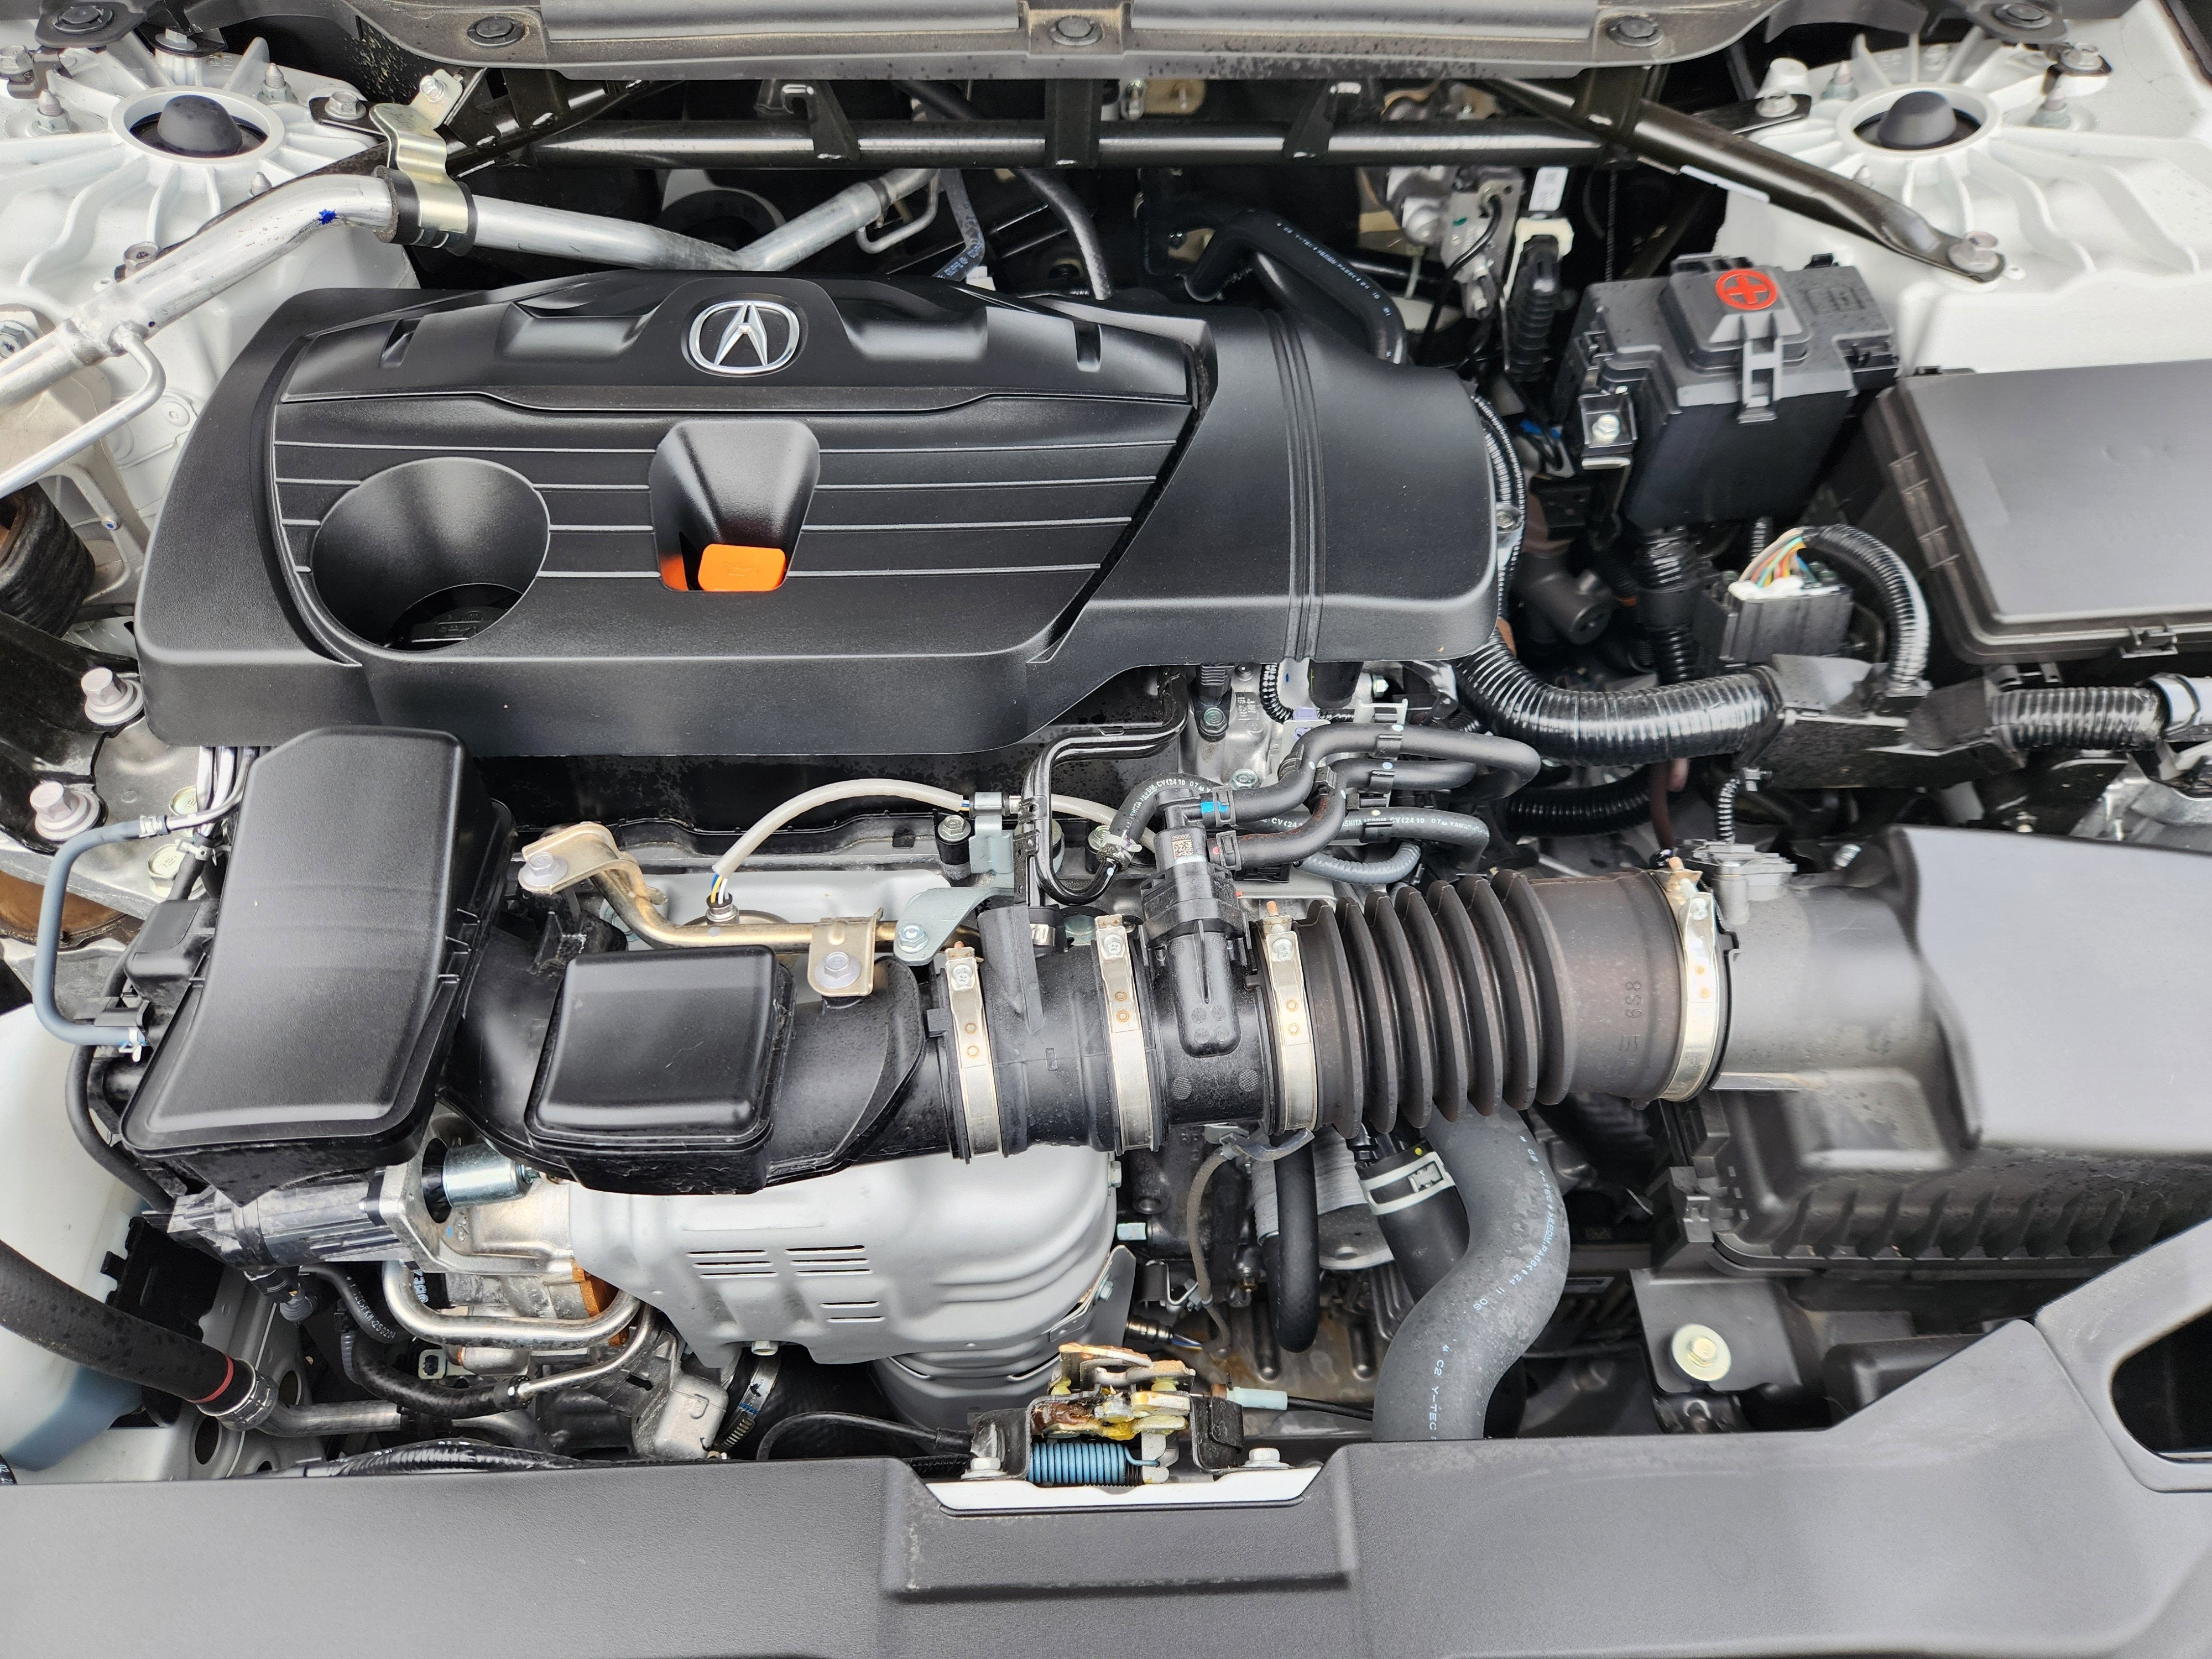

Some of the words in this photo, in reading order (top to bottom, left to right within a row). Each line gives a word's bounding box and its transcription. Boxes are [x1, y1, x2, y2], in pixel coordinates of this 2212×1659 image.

[1538, 1170, 1552, 1203] Y-TEC
[1509, 1274, 1522, 1286] 24
[1473, 1298, 1488, 1311] 06
[1434, 1359, 1444, 1376] C2
[1429, 1385, 1439, 1431] Y-TEC
